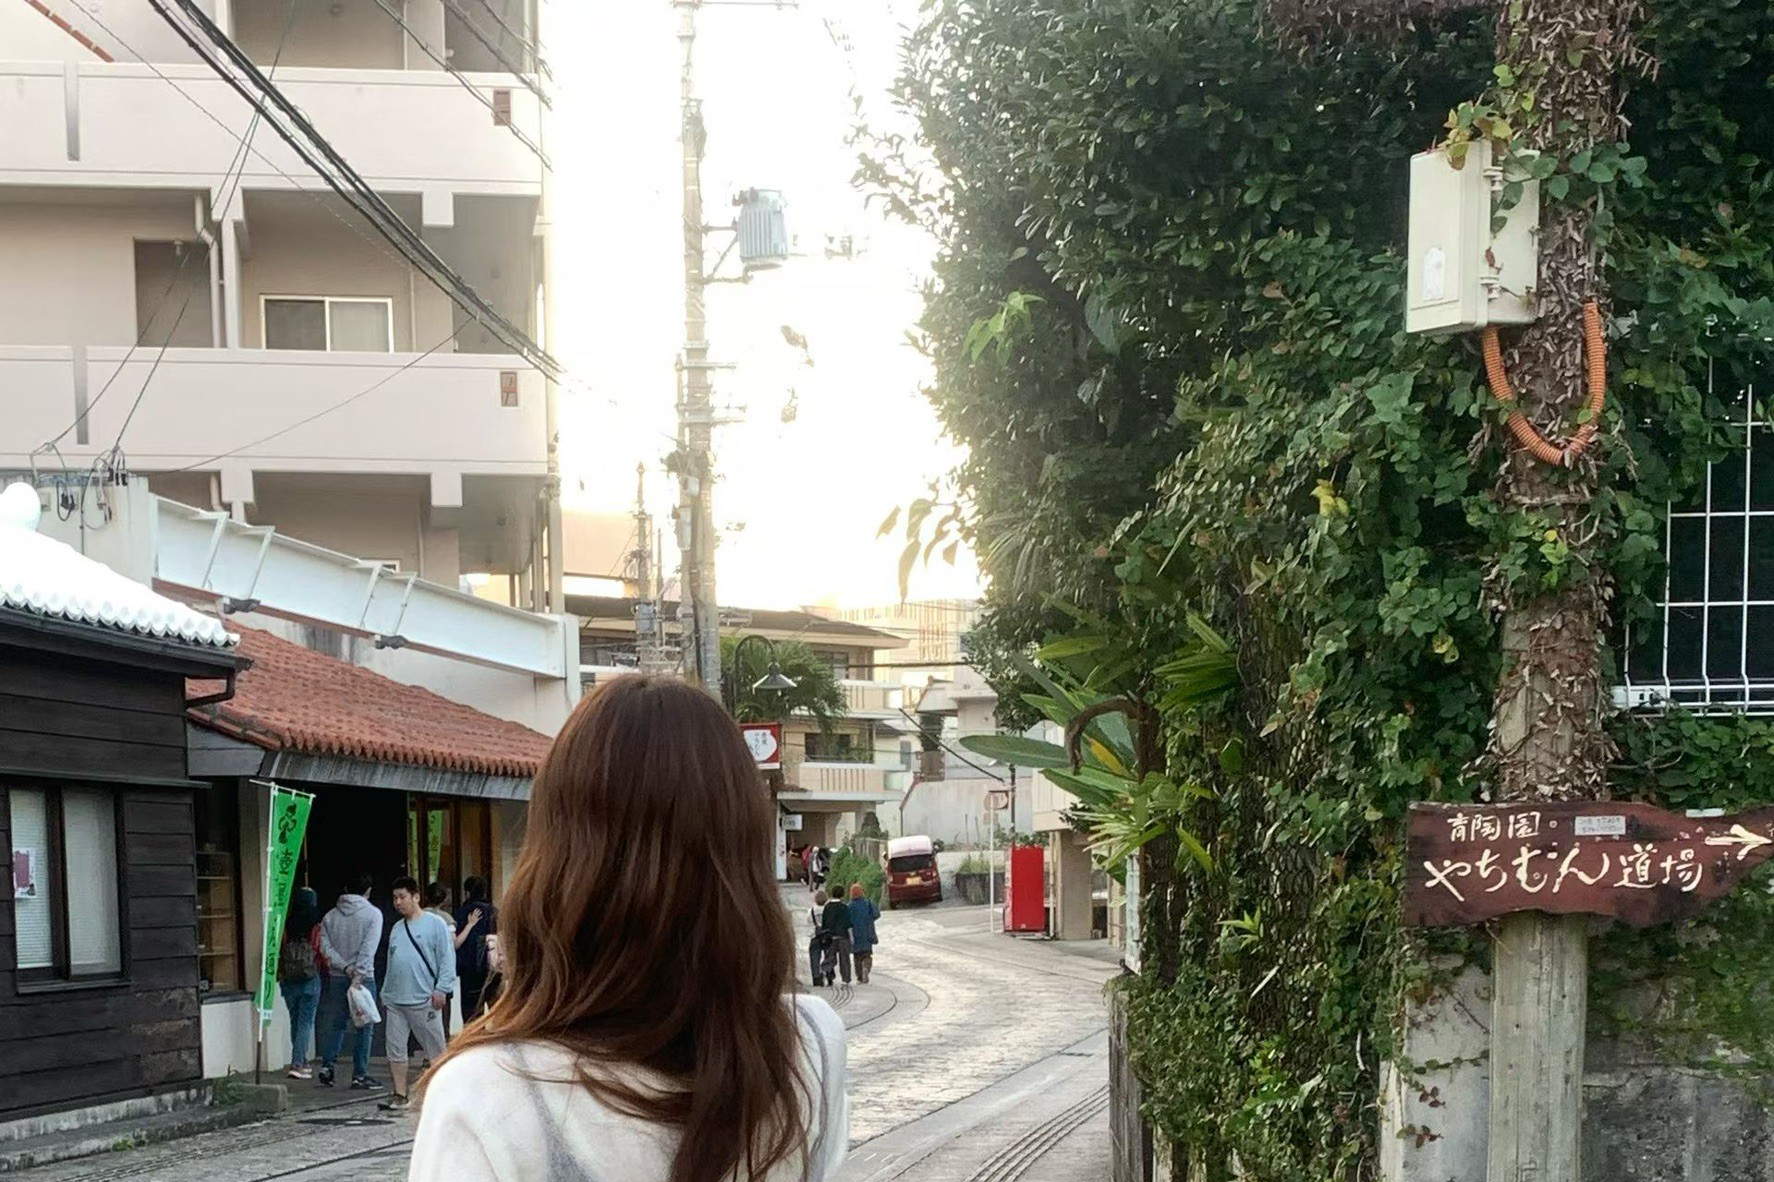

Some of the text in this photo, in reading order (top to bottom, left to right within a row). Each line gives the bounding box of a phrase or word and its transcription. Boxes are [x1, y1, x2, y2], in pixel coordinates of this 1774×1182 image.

[1423, 843, 1703, 902] やちむん道場
